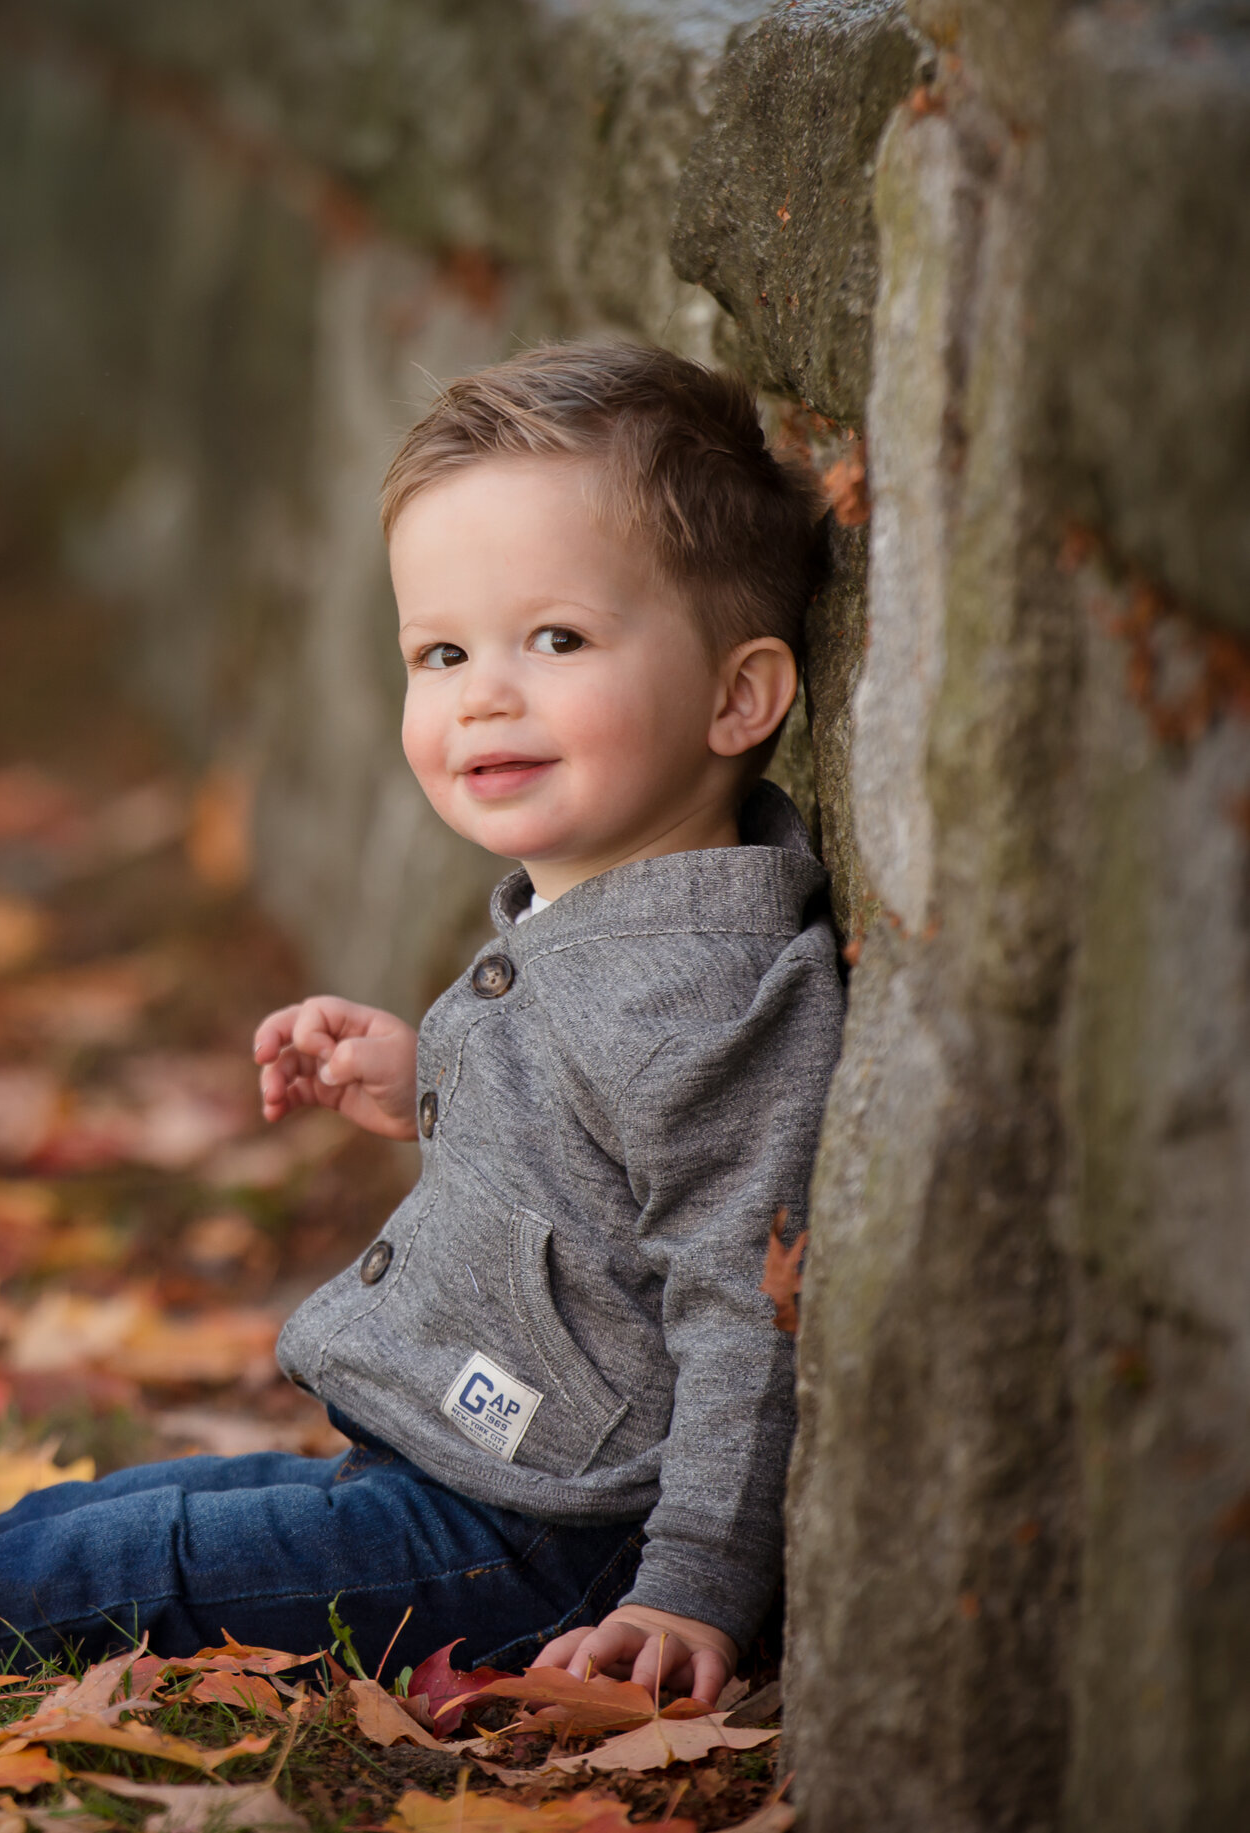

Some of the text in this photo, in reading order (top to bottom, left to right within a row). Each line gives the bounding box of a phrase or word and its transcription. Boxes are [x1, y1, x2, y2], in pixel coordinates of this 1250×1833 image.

[459, 1372, 520, 1417] GAP
[451, 1407, 507, 1446] NEW YORK CITY
[485, 1413, 508, 1431] 1969
